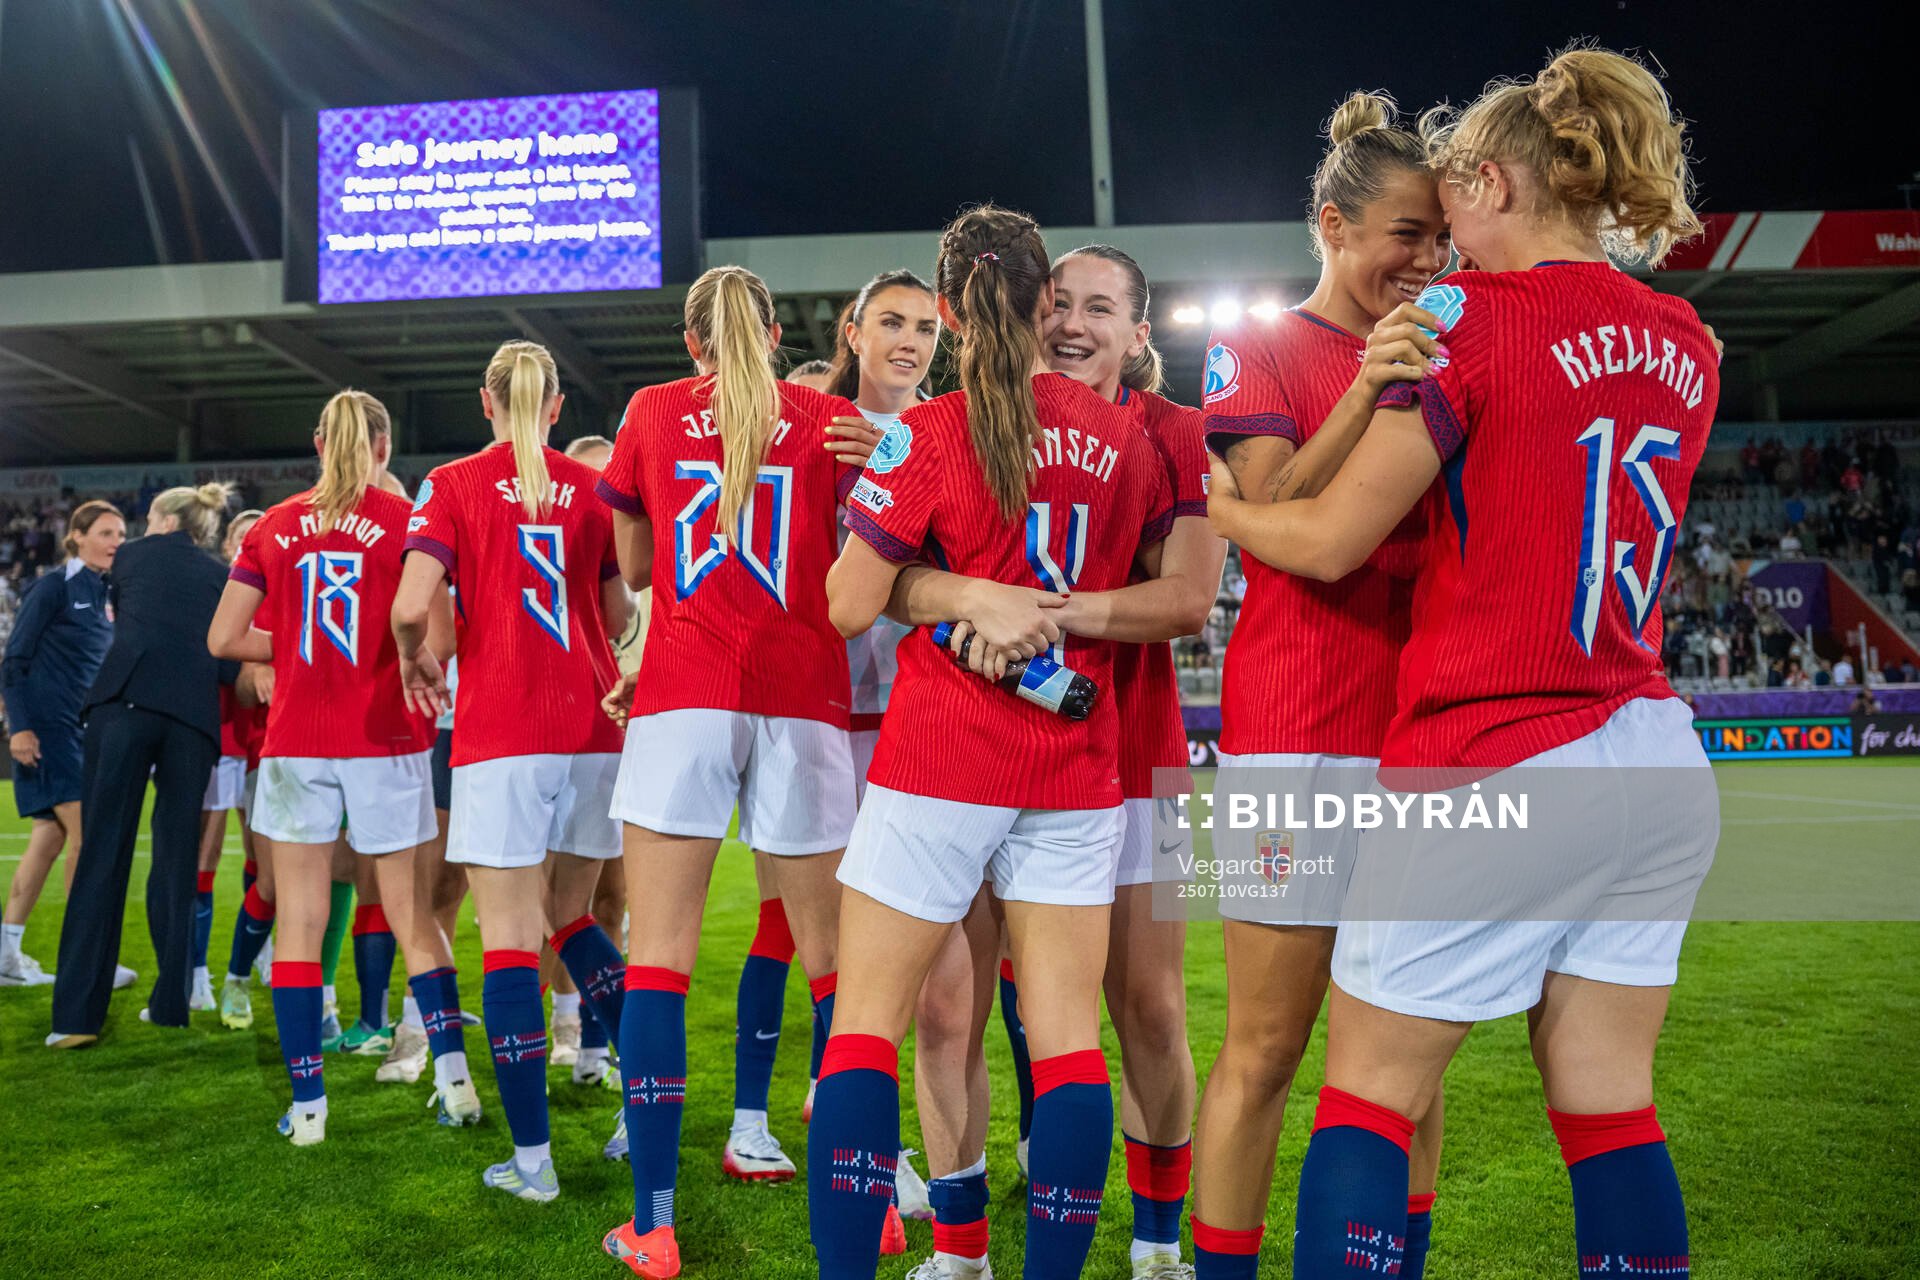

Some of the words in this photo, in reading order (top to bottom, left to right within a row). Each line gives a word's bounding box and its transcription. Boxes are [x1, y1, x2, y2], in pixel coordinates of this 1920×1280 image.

[356, 139, 419, 168] Safe
[422, 137, 533, 170] journey
[538, 131, 618, 157] home
[674, 460, 793, 613] 20
[1569, 416, 1681, 660] 15
[294, 550, 363, 668] 18
[1860, 723, 1891, 756] for
